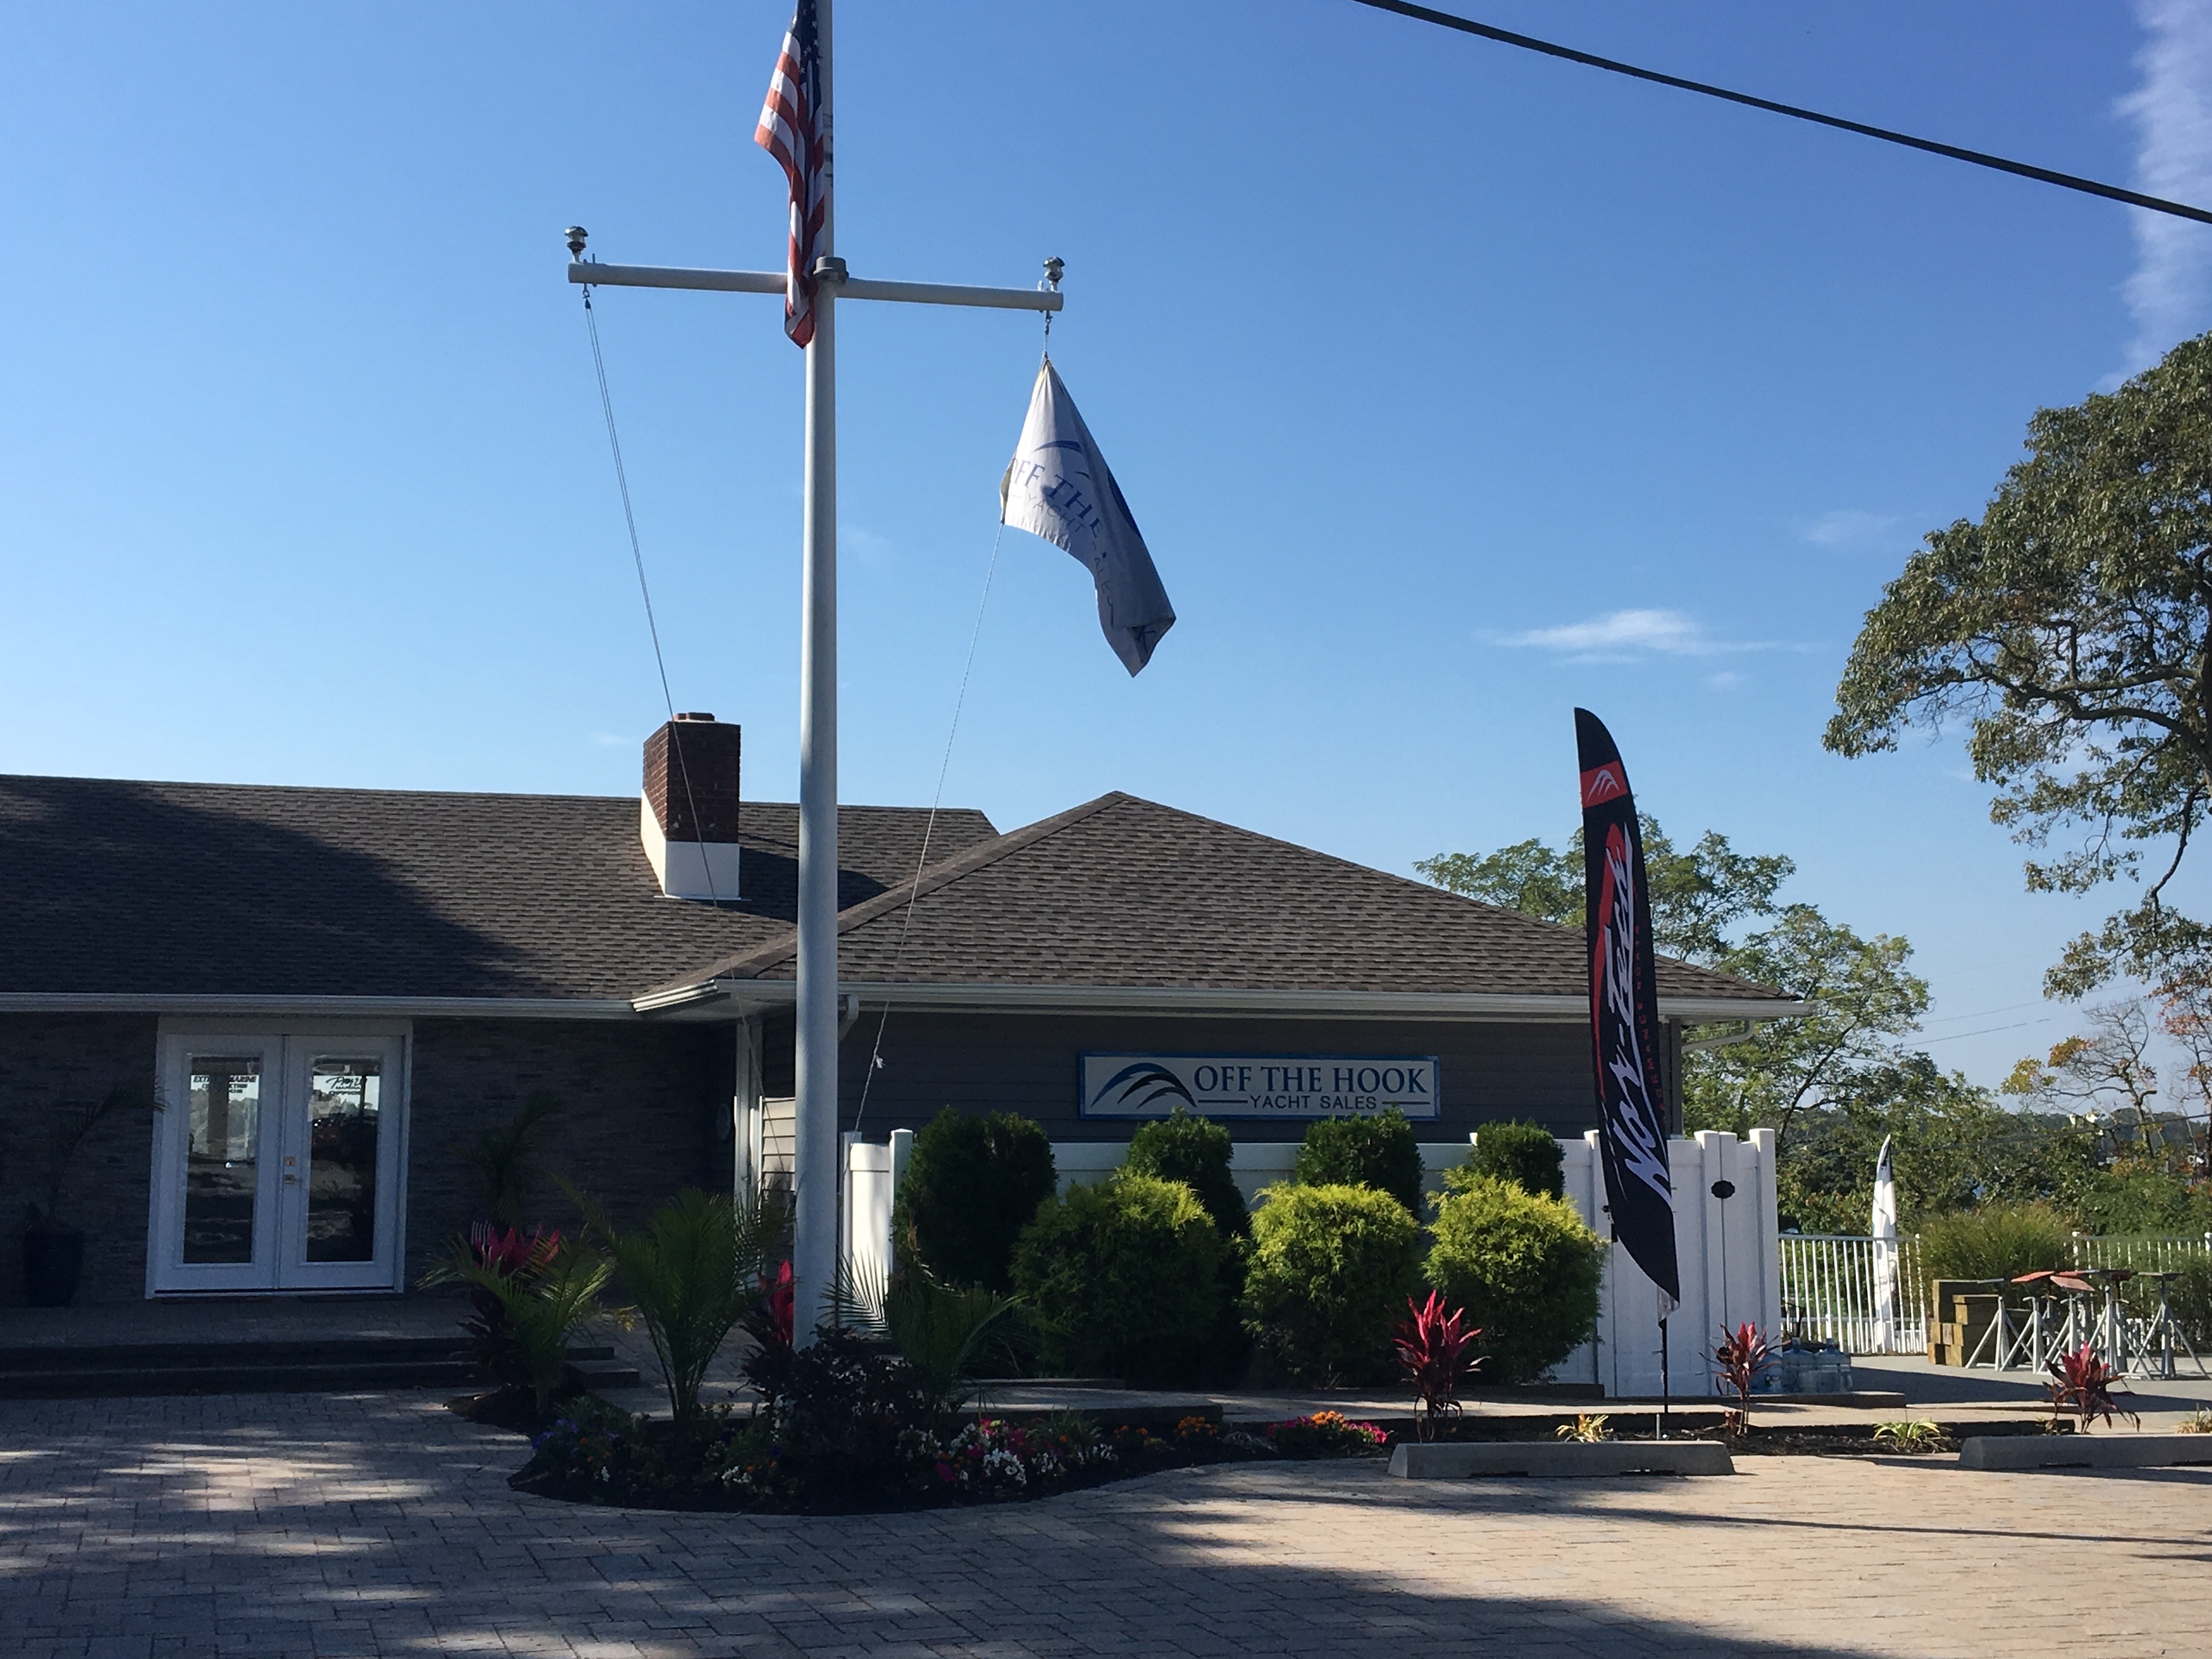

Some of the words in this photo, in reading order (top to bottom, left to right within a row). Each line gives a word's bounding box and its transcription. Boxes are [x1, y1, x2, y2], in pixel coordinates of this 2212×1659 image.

[1027, 493, 1085, 532] YACHT
[1048, 473, 1103, 538] THE
[1604, 822, 1672, 1208] Nor-Tech
[1194, 1065, 1251, 1092] OFF
[1260, 1066, 1322, 1092] THE
[1332, 1067, 1429, 1094] HOOK
[1250, 1095, 1311, 1109] YACHT
[1319, 1096, 1377, 1109] SALES
